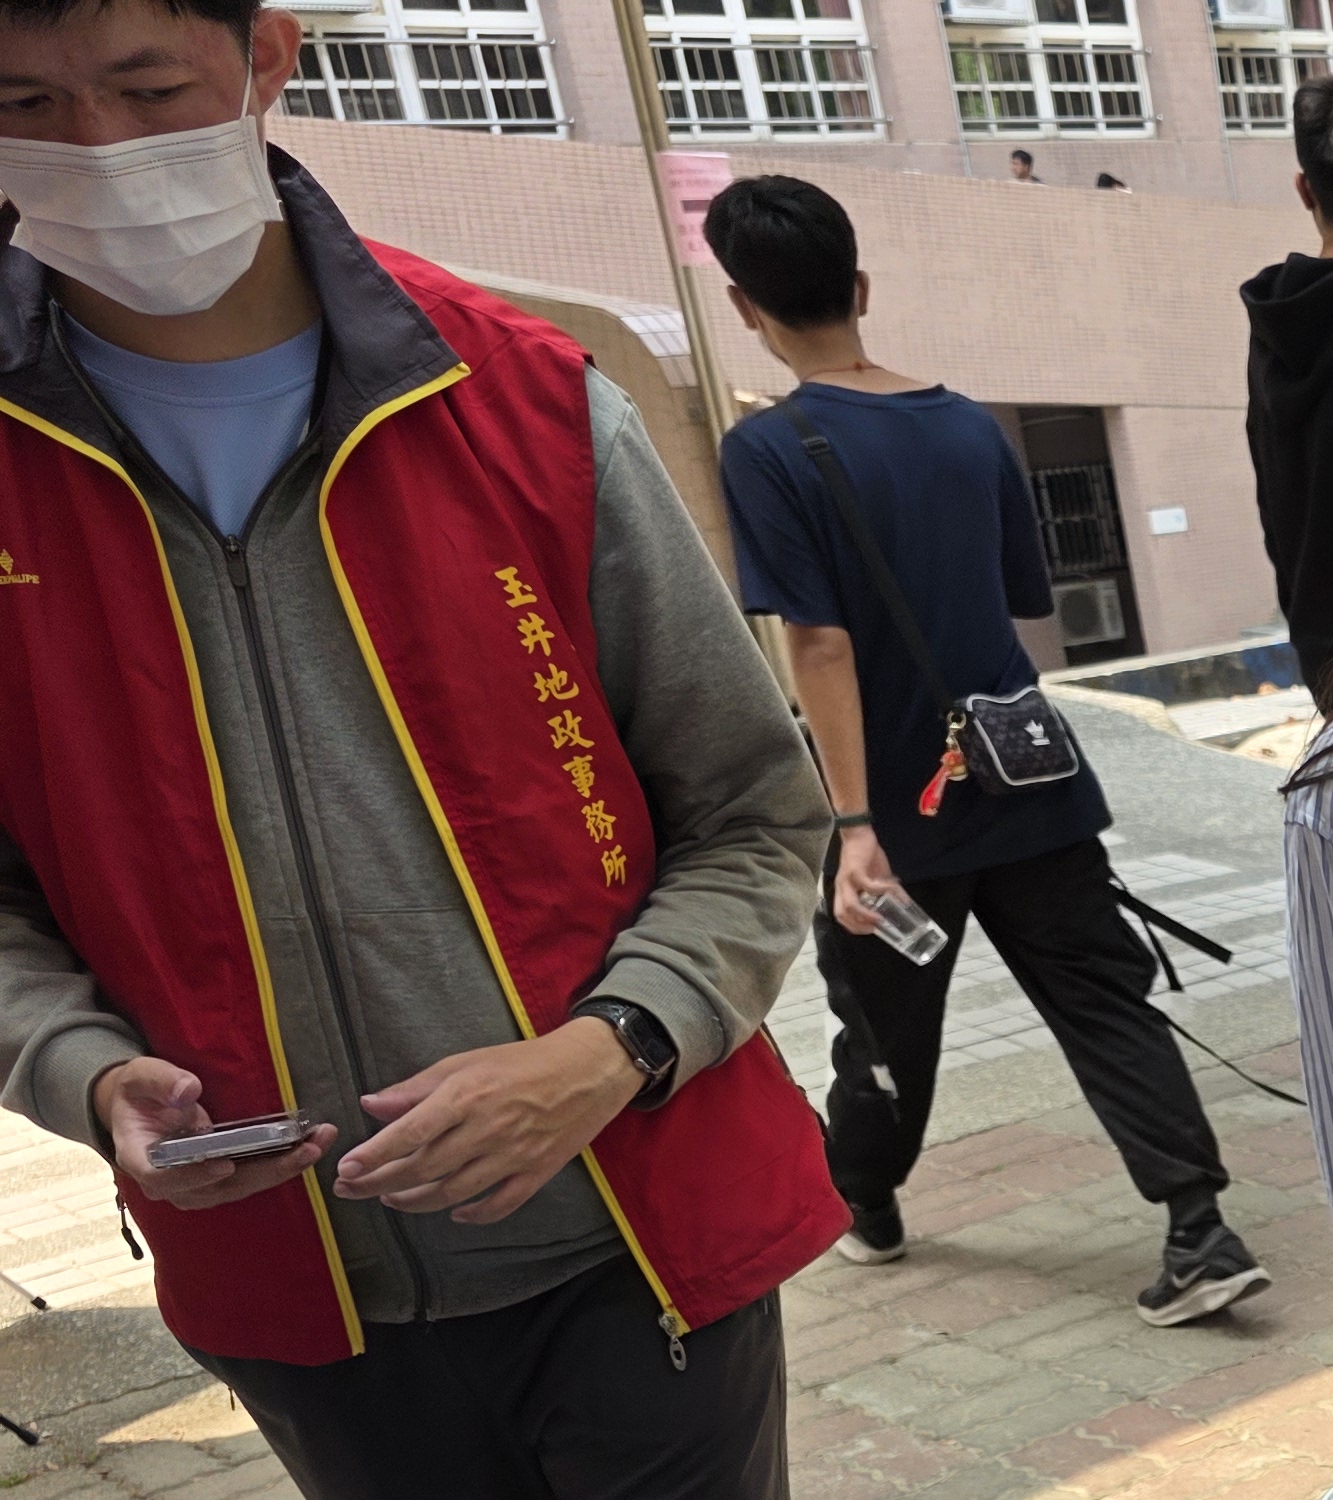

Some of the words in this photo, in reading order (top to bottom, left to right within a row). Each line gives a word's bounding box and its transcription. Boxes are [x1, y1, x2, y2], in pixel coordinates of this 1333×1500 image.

[494, 564, 628, 887] 玉井地政事務所
